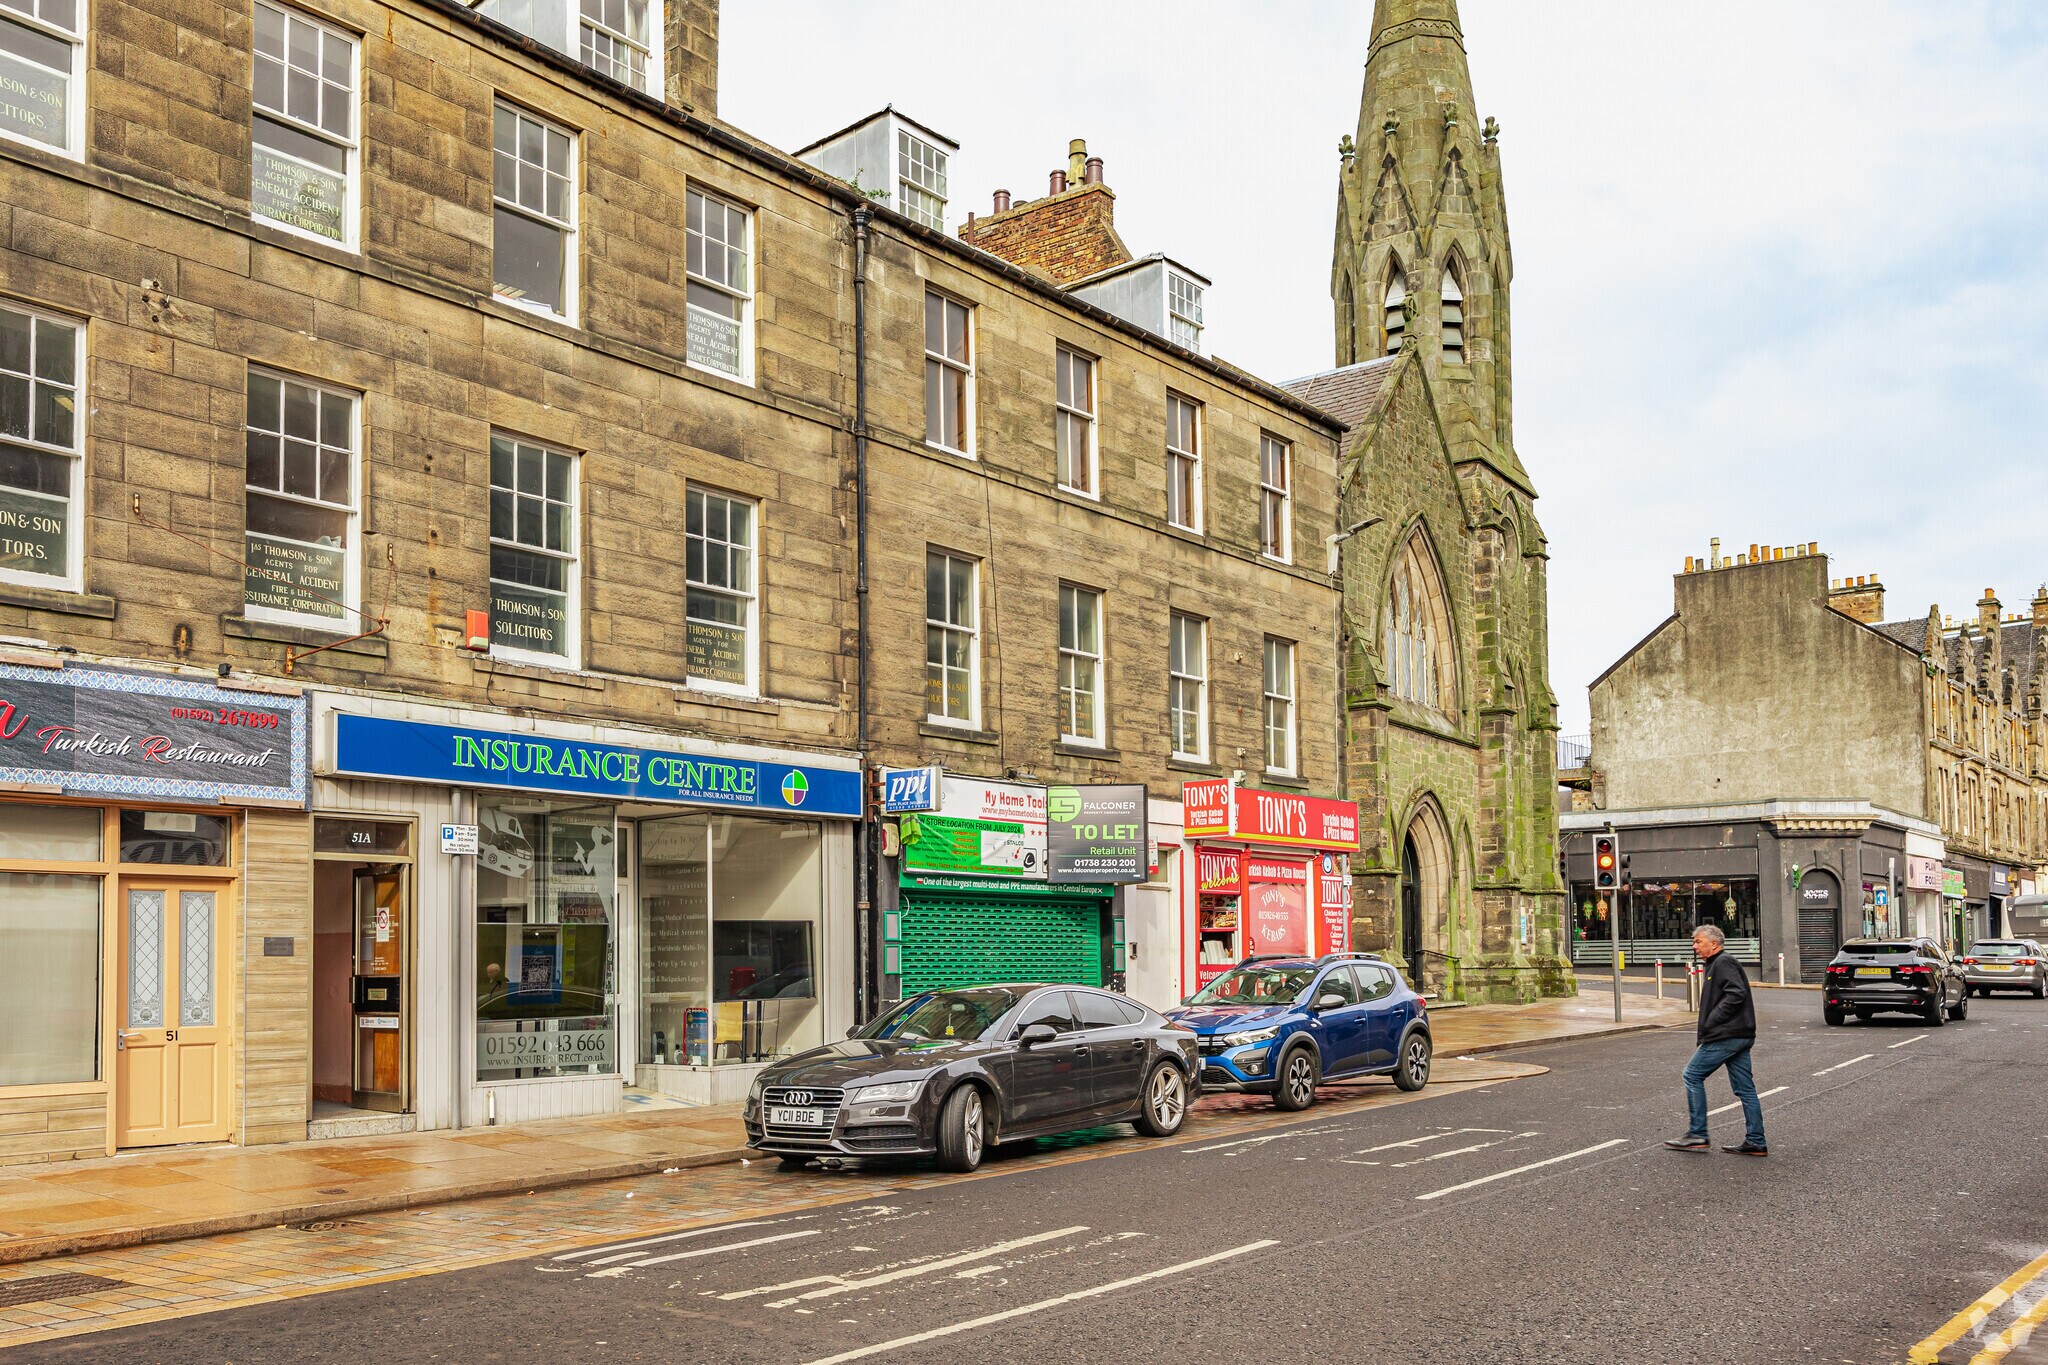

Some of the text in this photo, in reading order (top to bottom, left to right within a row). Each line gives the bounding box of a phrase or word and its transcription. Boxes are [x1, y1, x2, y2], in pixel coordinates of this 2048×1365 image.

[30, 88, 38, 98] &
[40, 91, 62, 108] SON
[264, 157, 337, 192] THOMSON & SON
[265, 170, 324, 198] AGENTS FOR
[272, 198, 290, 210] FIRE
[301, 207, 318, 220] LIFE
[293, 192, 340, 216] ACCIDENT
[689, 312, 719, 330] THOMSON
[726, 326, 738, 336] SON
[689, 323, 726, 341] AGENTS FOR
[18, 514, 30, 528] &
[33, 516, 61, 534] SON
[264, 545, 306, 561] THOMSON
[316, 555, 332, 566] SON
[264, 558, 318, 574] AGENTS FOR
[246, 566, 340, 591] GENERAL ACCIDENT
[272, 584, 288, 594] FIRE
[298, 590, 312, 598] LIFE
[496, 598, 540, 617] THOMSON
[548, 608, 566, 622] SON
[496, 620, 552, 640] SOLICITORS
[688, 624, 722, 638] THOMSON
[712, 648, 740, 660] ACCIDENT
[171, 707, 278, 729] (01592) 267899
[36, 726, 282, 768] Turkish Restaurant
[452, 736, 756, 794] INSURANCE CENTRE
[888, 769, 930, 802] ppi
[703, 792, 734, 800] INSURANCE
[986, 790, 1024, 806] My Home
[1084, 802, 1136, 810] FALCONER
[1184, 784, 1228, 808] TONY'S
[926, 818, 946, 827] STORE
[946, 820, 974, 830] LOCATION
[976, 823, 992, 832] FROM
[993, 824, 1006, 832] JULY
[1258, 796, 1306, 836] TONY'S
[352, 832, 372, 844] 51A
[1072, 824, 1138, 840] TO LET
[1090, 846, 1116, 854] Retail
[1200, 854, 1238, 882] TONY'S
[923, 876, 936, 886] One
[936, 877, 942, 886] of
[943, 877, 952, 886] the
[952, 878, 972, 889] largest
[972, 880, 998, 888] multi-tool
[1000, 881, 1010, 889] and
[1011, 882, 1020, 890] PPE
[1063, 884, 1080, 892] Central
[1201, 874, 1240, 890] welcome
[1261, 890, 1286, 908] TONY'S
[166, 1030, 178, 1042] 51
[486, 1036, 536, 1054] 01592
[577, 1034, 605, 1052] 666
[778, 1110, 814, 1122] YC11 BDE
